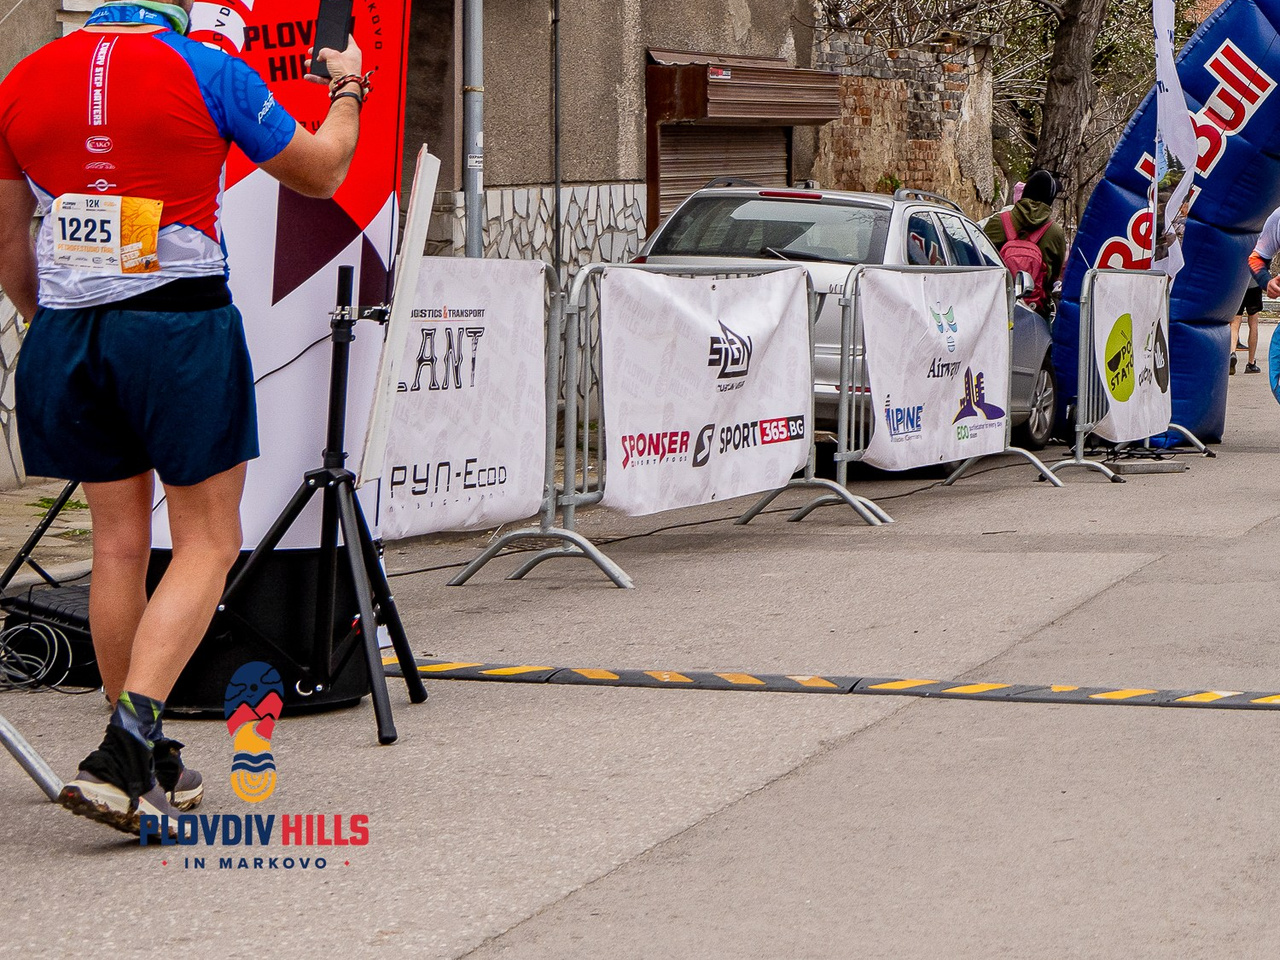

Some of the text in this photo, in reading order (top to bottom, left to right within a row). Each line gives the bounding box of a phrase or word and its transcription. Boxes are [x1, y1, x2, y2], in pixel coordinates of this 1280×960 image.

[243, 16, 355, 52] PLOV
[94, 67, 104, 88] STEP
[92, 89, 102, 126] MATTERS
[86, 199, 100, 208] 12K
[57, 217, 112, 243] 1225
[448, 309, 485, 318] TRANSPORT
[397, 326, 485, 393] ANT
[621, 430, 691, 469] SPONSER
